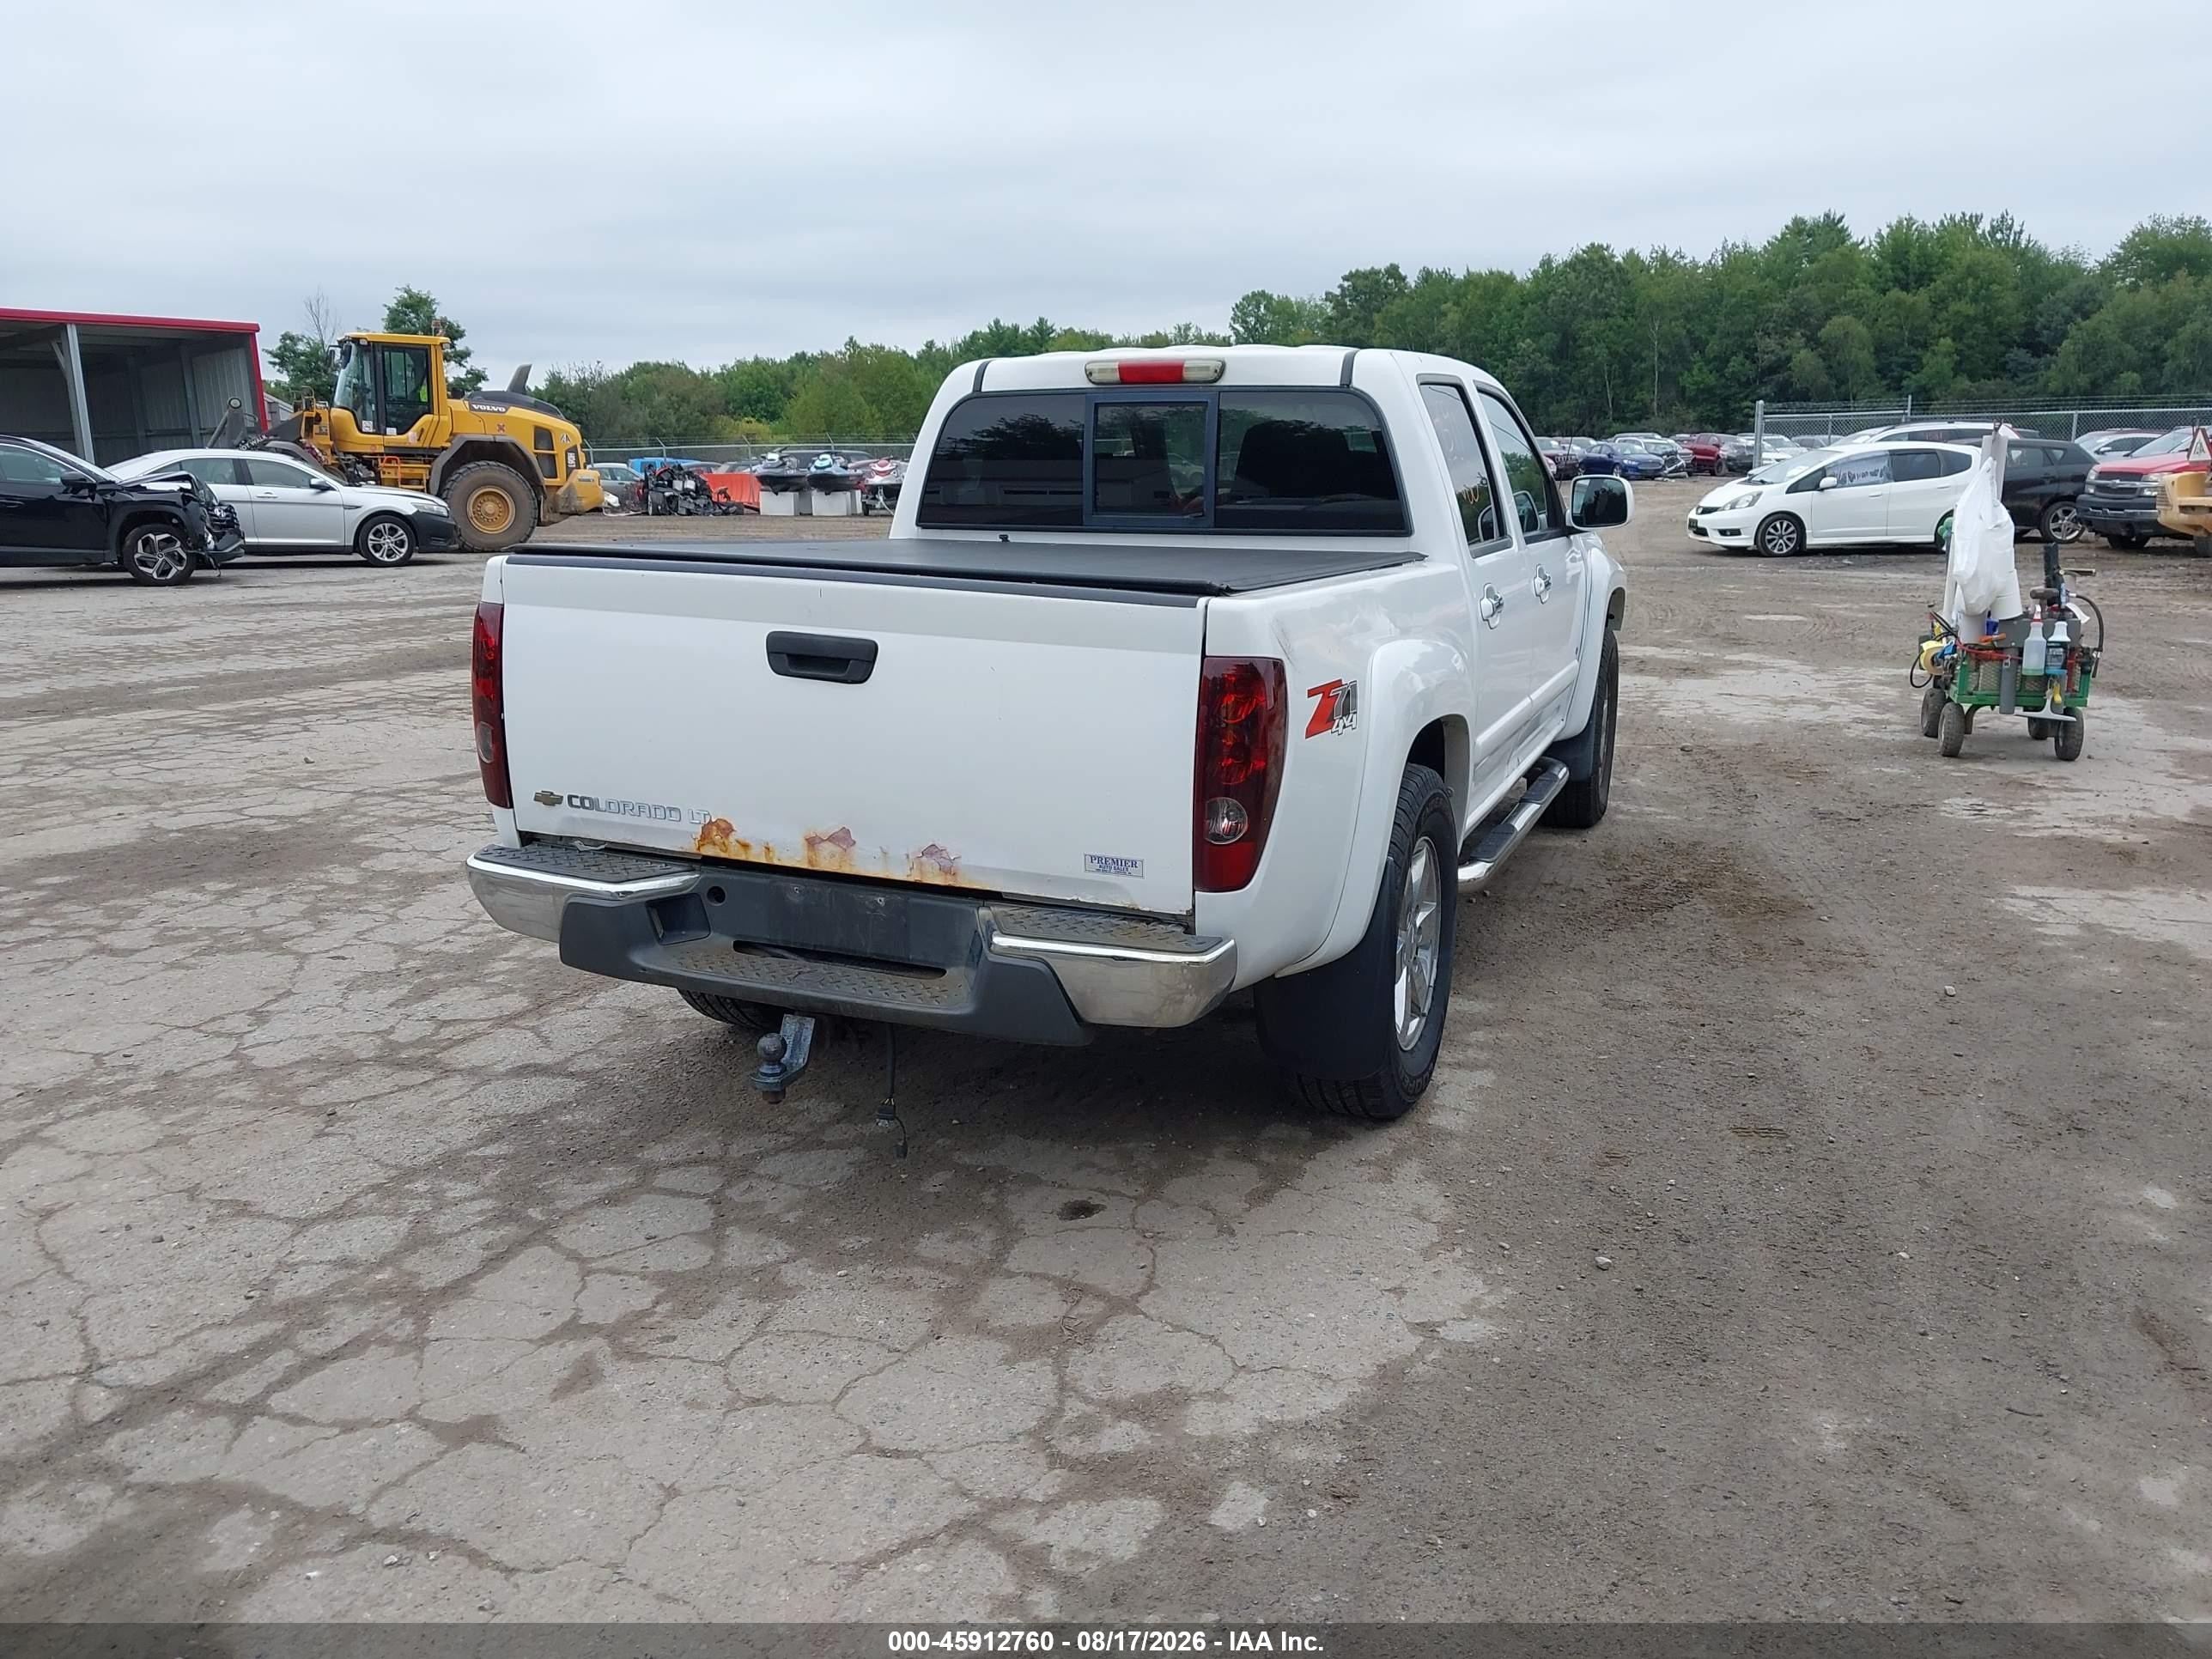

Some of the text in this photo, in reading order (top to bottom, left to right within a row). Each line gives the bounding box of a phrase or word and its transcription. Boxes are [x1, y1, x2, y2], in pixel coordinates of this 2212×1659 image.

[1305, 678, 1358, 739] Z71
[567, 794, 711, 825] COLORADO LT
[1090, 855, 1138, 868] PREMIER
